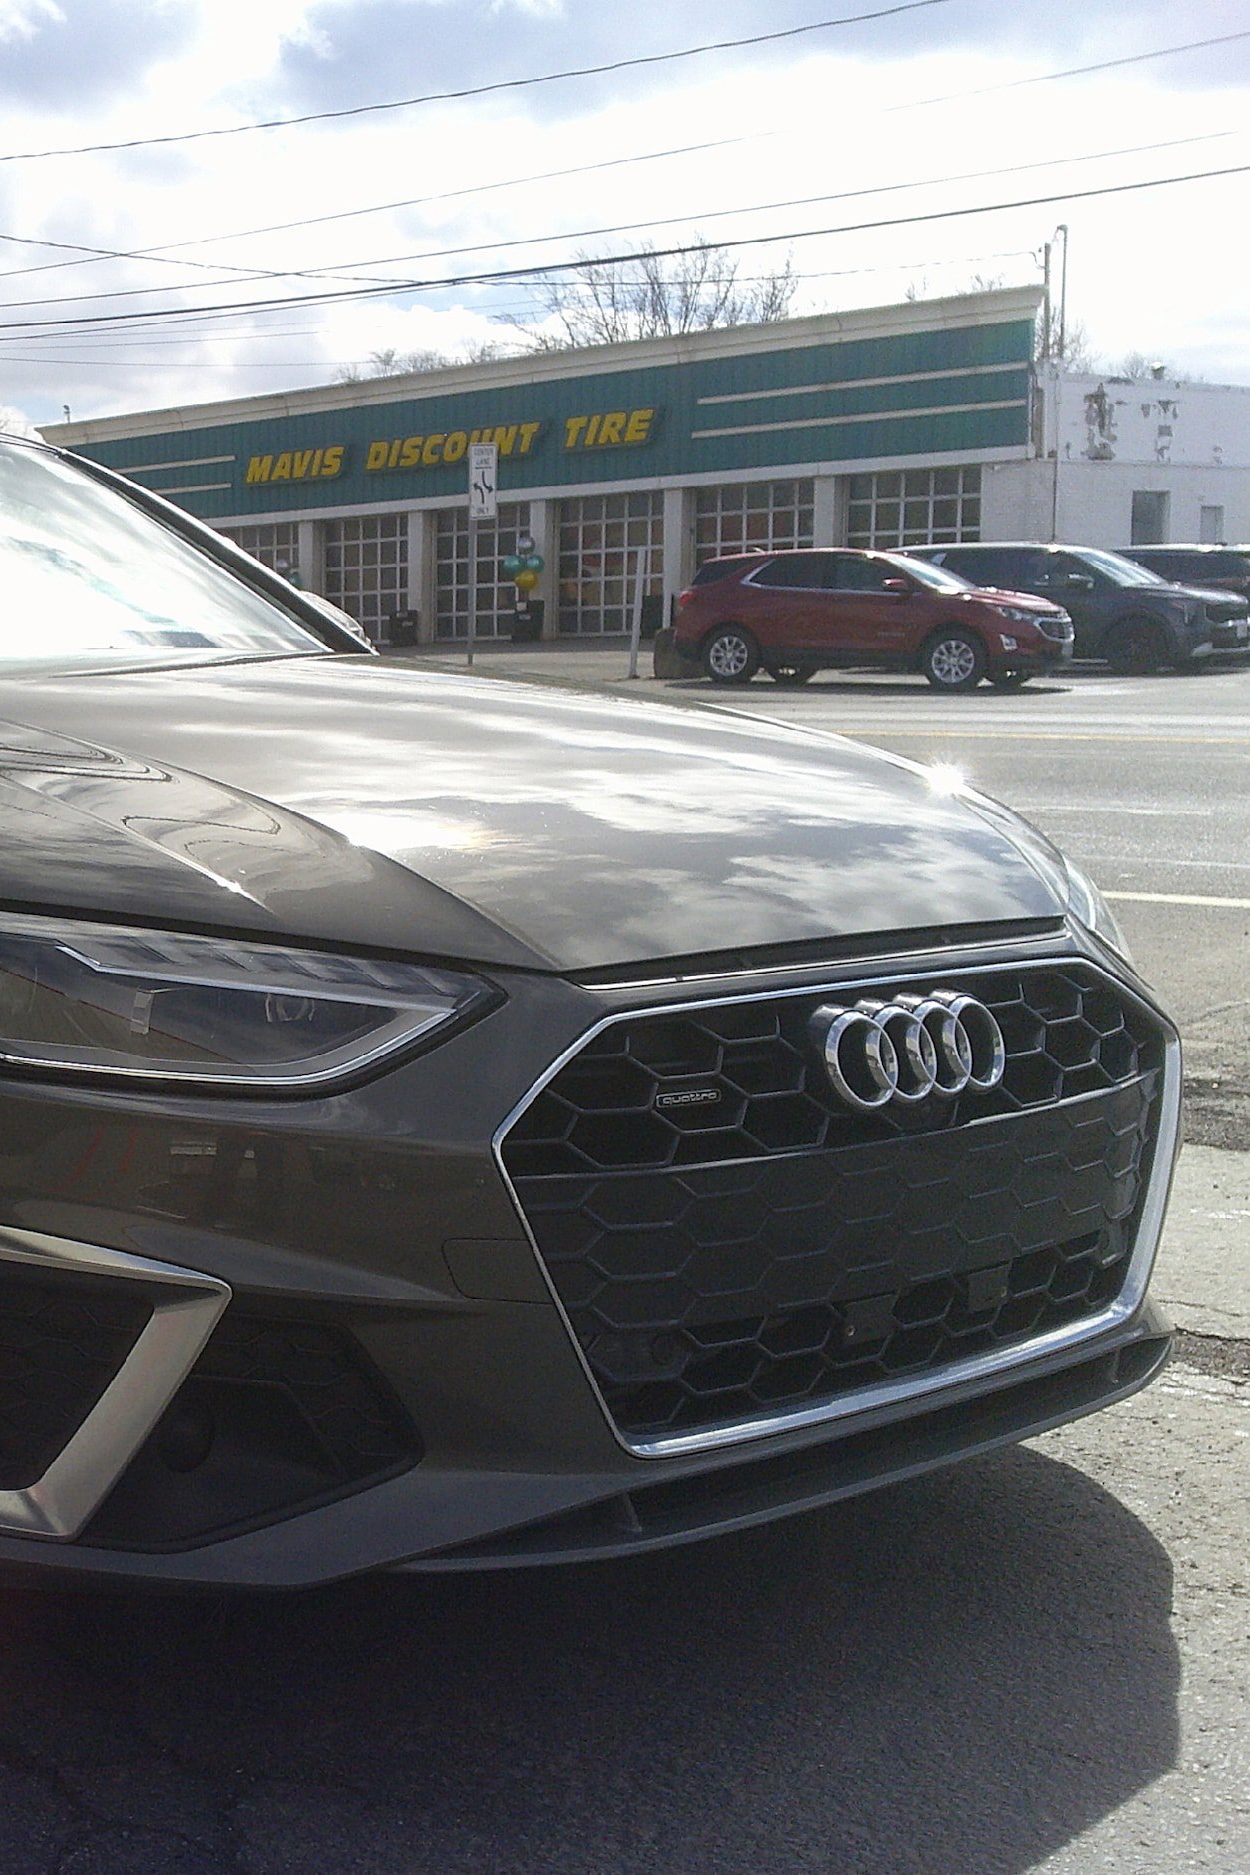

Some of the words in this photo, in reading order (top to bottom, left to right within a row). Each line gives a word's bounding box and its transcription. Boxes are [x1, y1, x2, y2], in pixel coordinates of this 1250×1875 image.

[246, 446, 345, 484] MAVIS
[565, 408, 654, 449] TIRE
[662, 1091, 717, 1105] quattro
